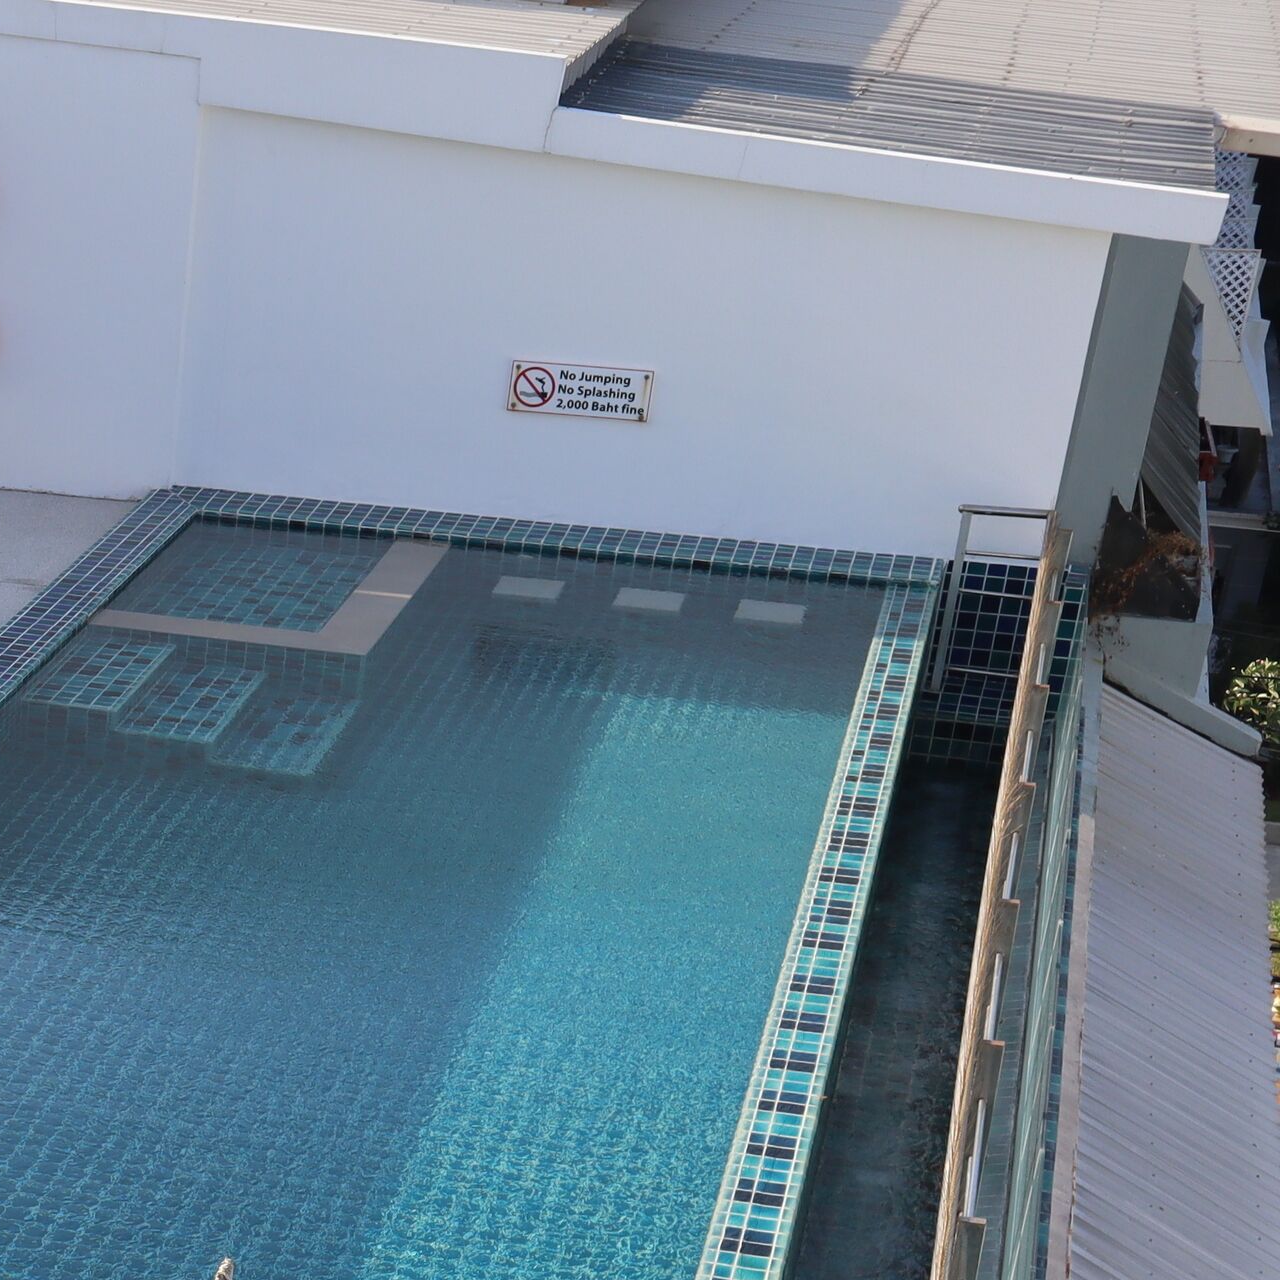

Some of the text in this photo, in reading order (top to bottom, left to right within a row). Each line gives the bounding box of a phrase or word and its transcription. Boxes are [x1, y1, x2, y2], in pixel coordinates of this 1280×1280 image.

[559, 370, 631, 388] No Jumping
[557, 384, 636, 402] No Splashing
[556, 399, 645, 416] 2,000 Baht fine
